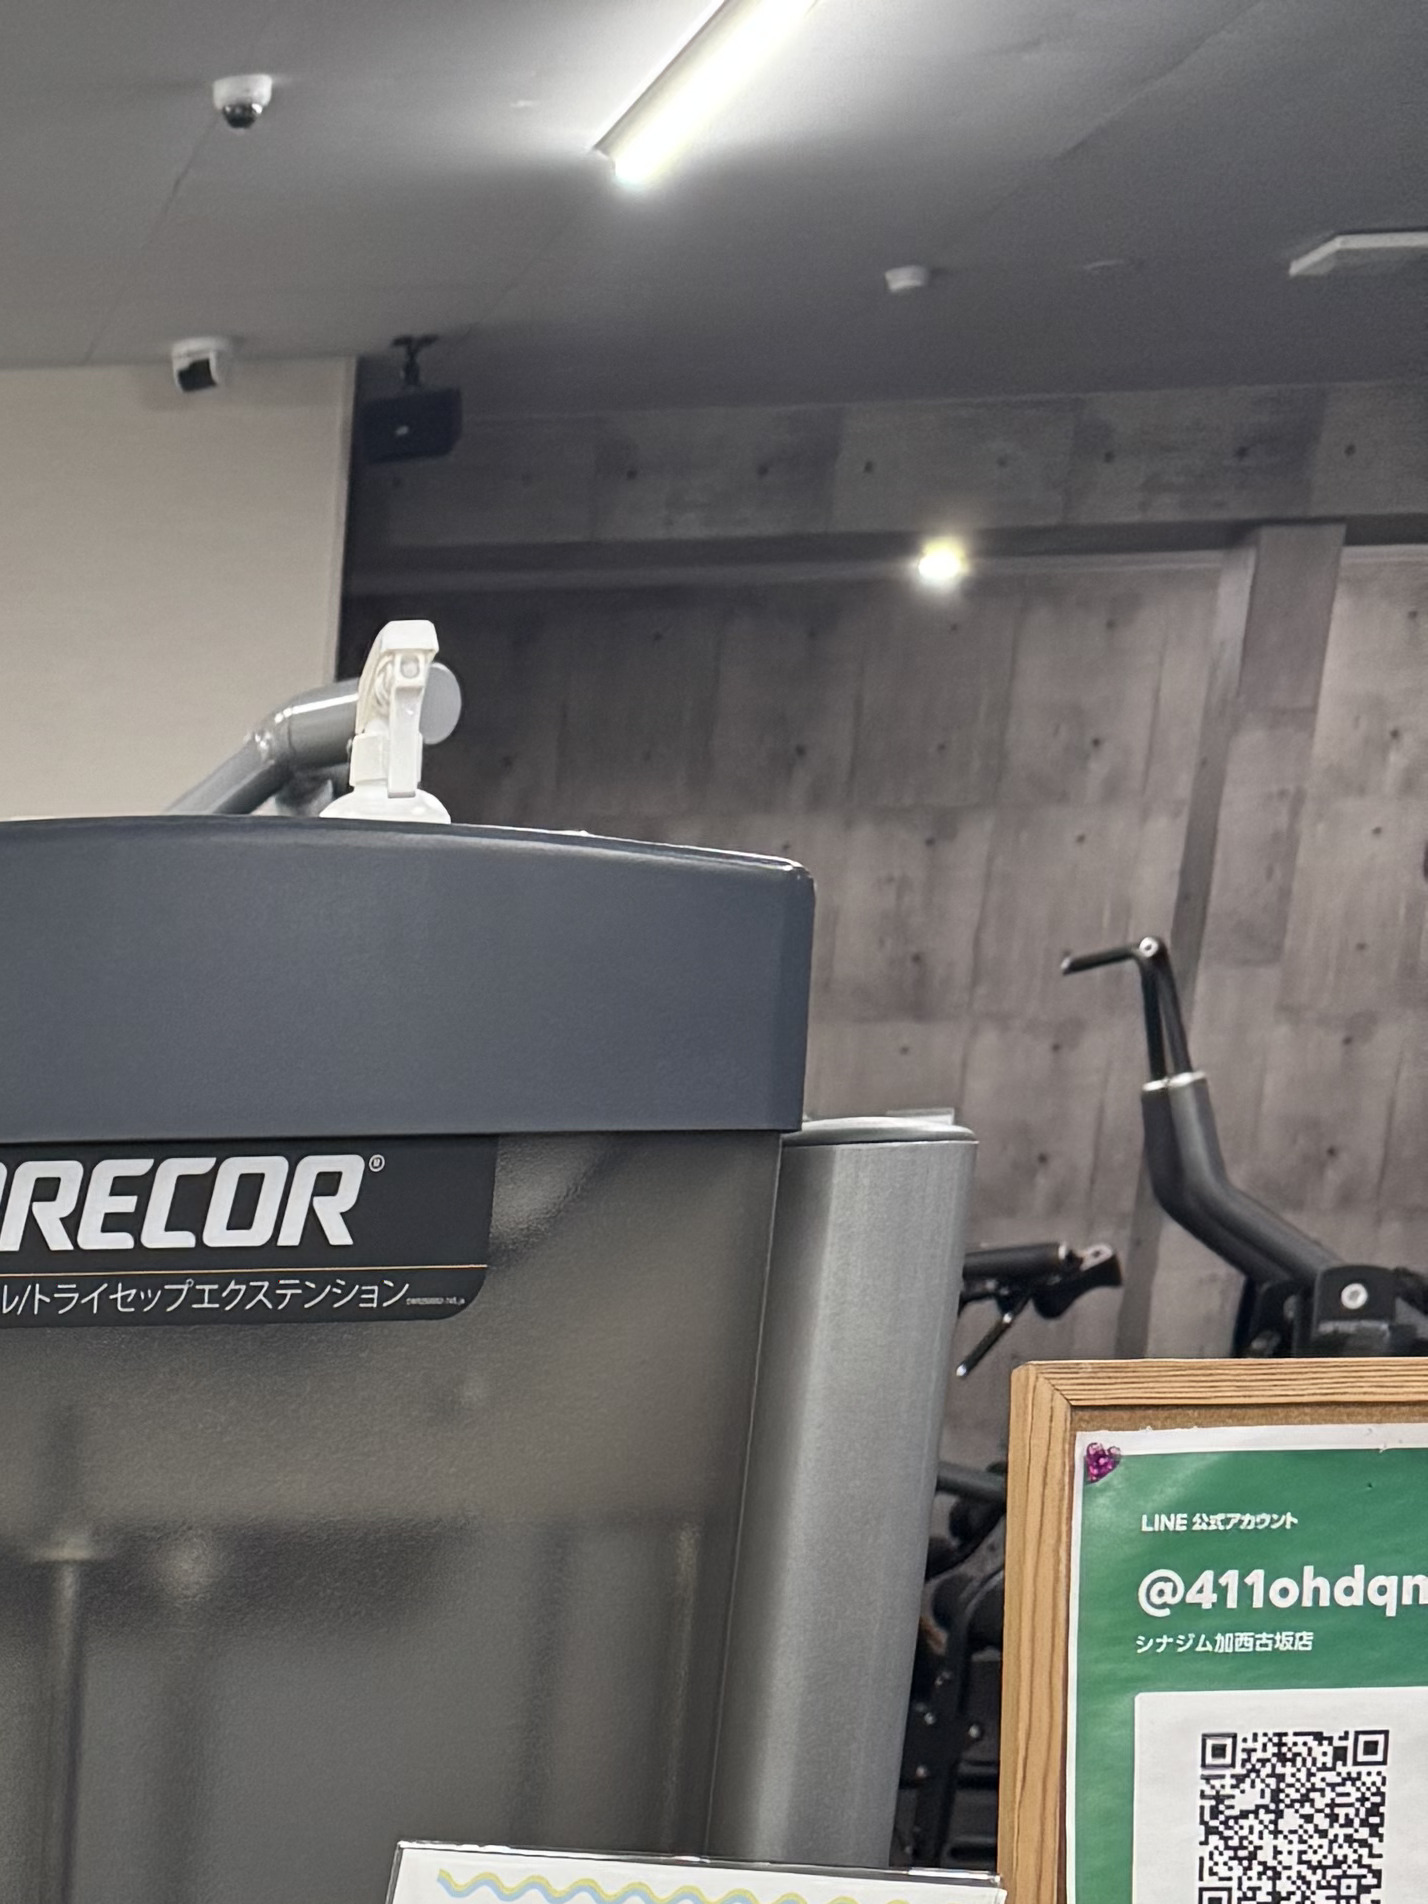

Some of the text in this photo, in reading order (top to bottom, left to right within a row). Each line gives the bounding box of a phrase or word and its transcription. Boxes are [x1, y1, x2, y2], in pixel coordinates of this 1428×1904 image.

[1141, 1512, 1298, 1532] LINE 公式アカウント
[1136, 1632, 1314, 1653] シナジム加西古坂店
